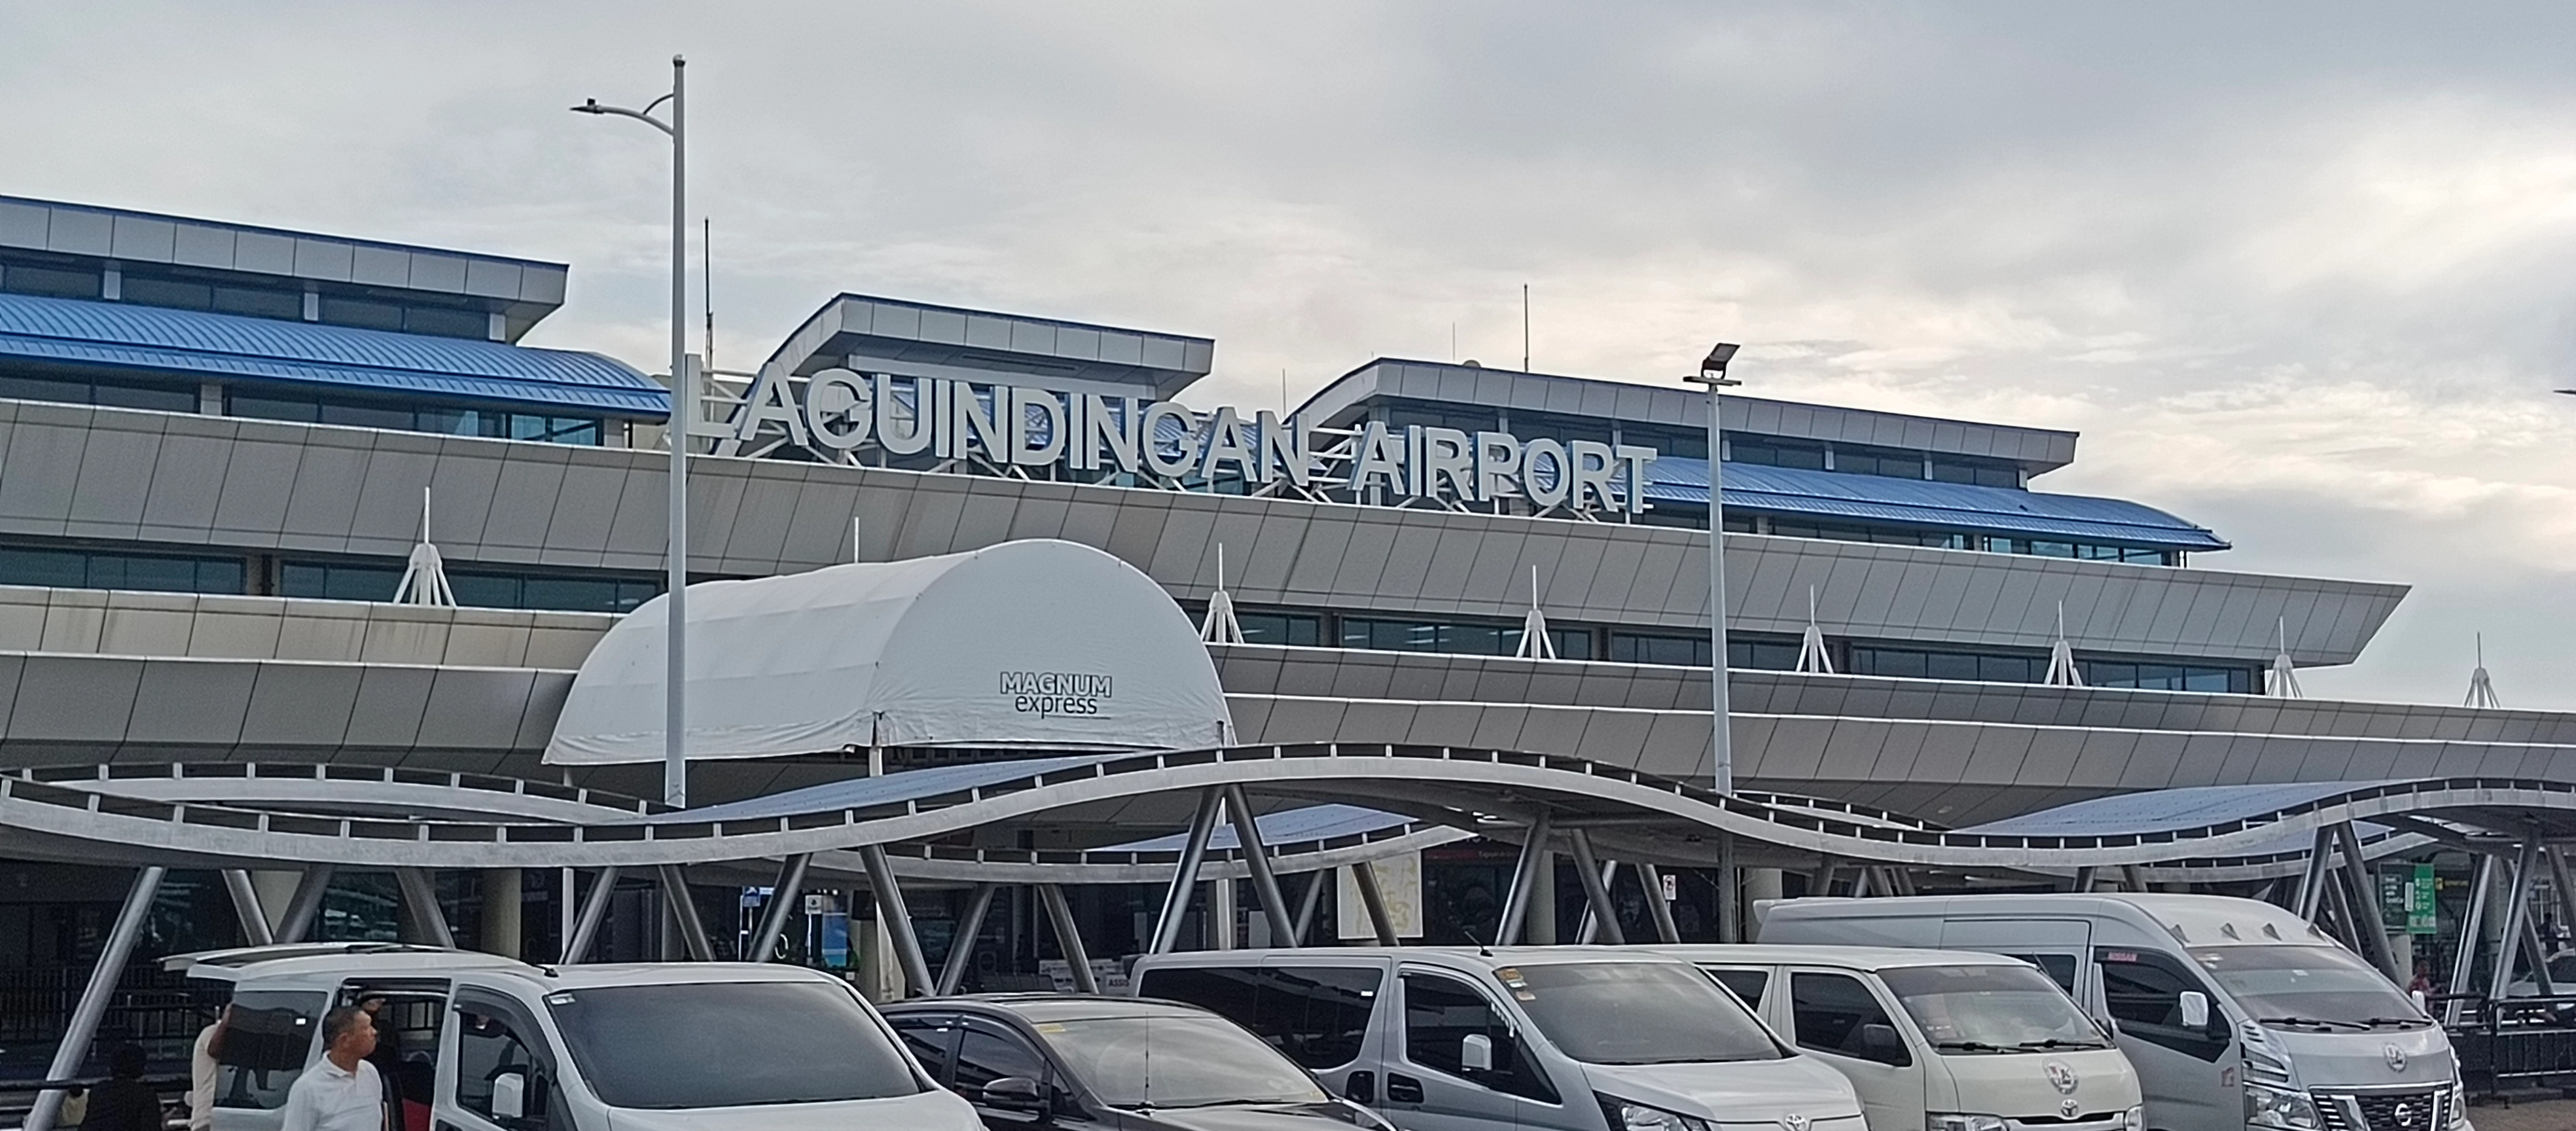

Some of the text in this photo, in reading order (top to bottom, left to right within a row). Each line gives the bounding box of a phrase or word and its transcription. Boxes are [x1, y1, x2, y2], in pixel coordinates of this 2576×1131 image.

[685, 353, 1657, 514] LAGUINDINGAN AIRPORT
[1000, 672, 1113, 698] MAGNUM
[1015, 696, 1098, 719] express
